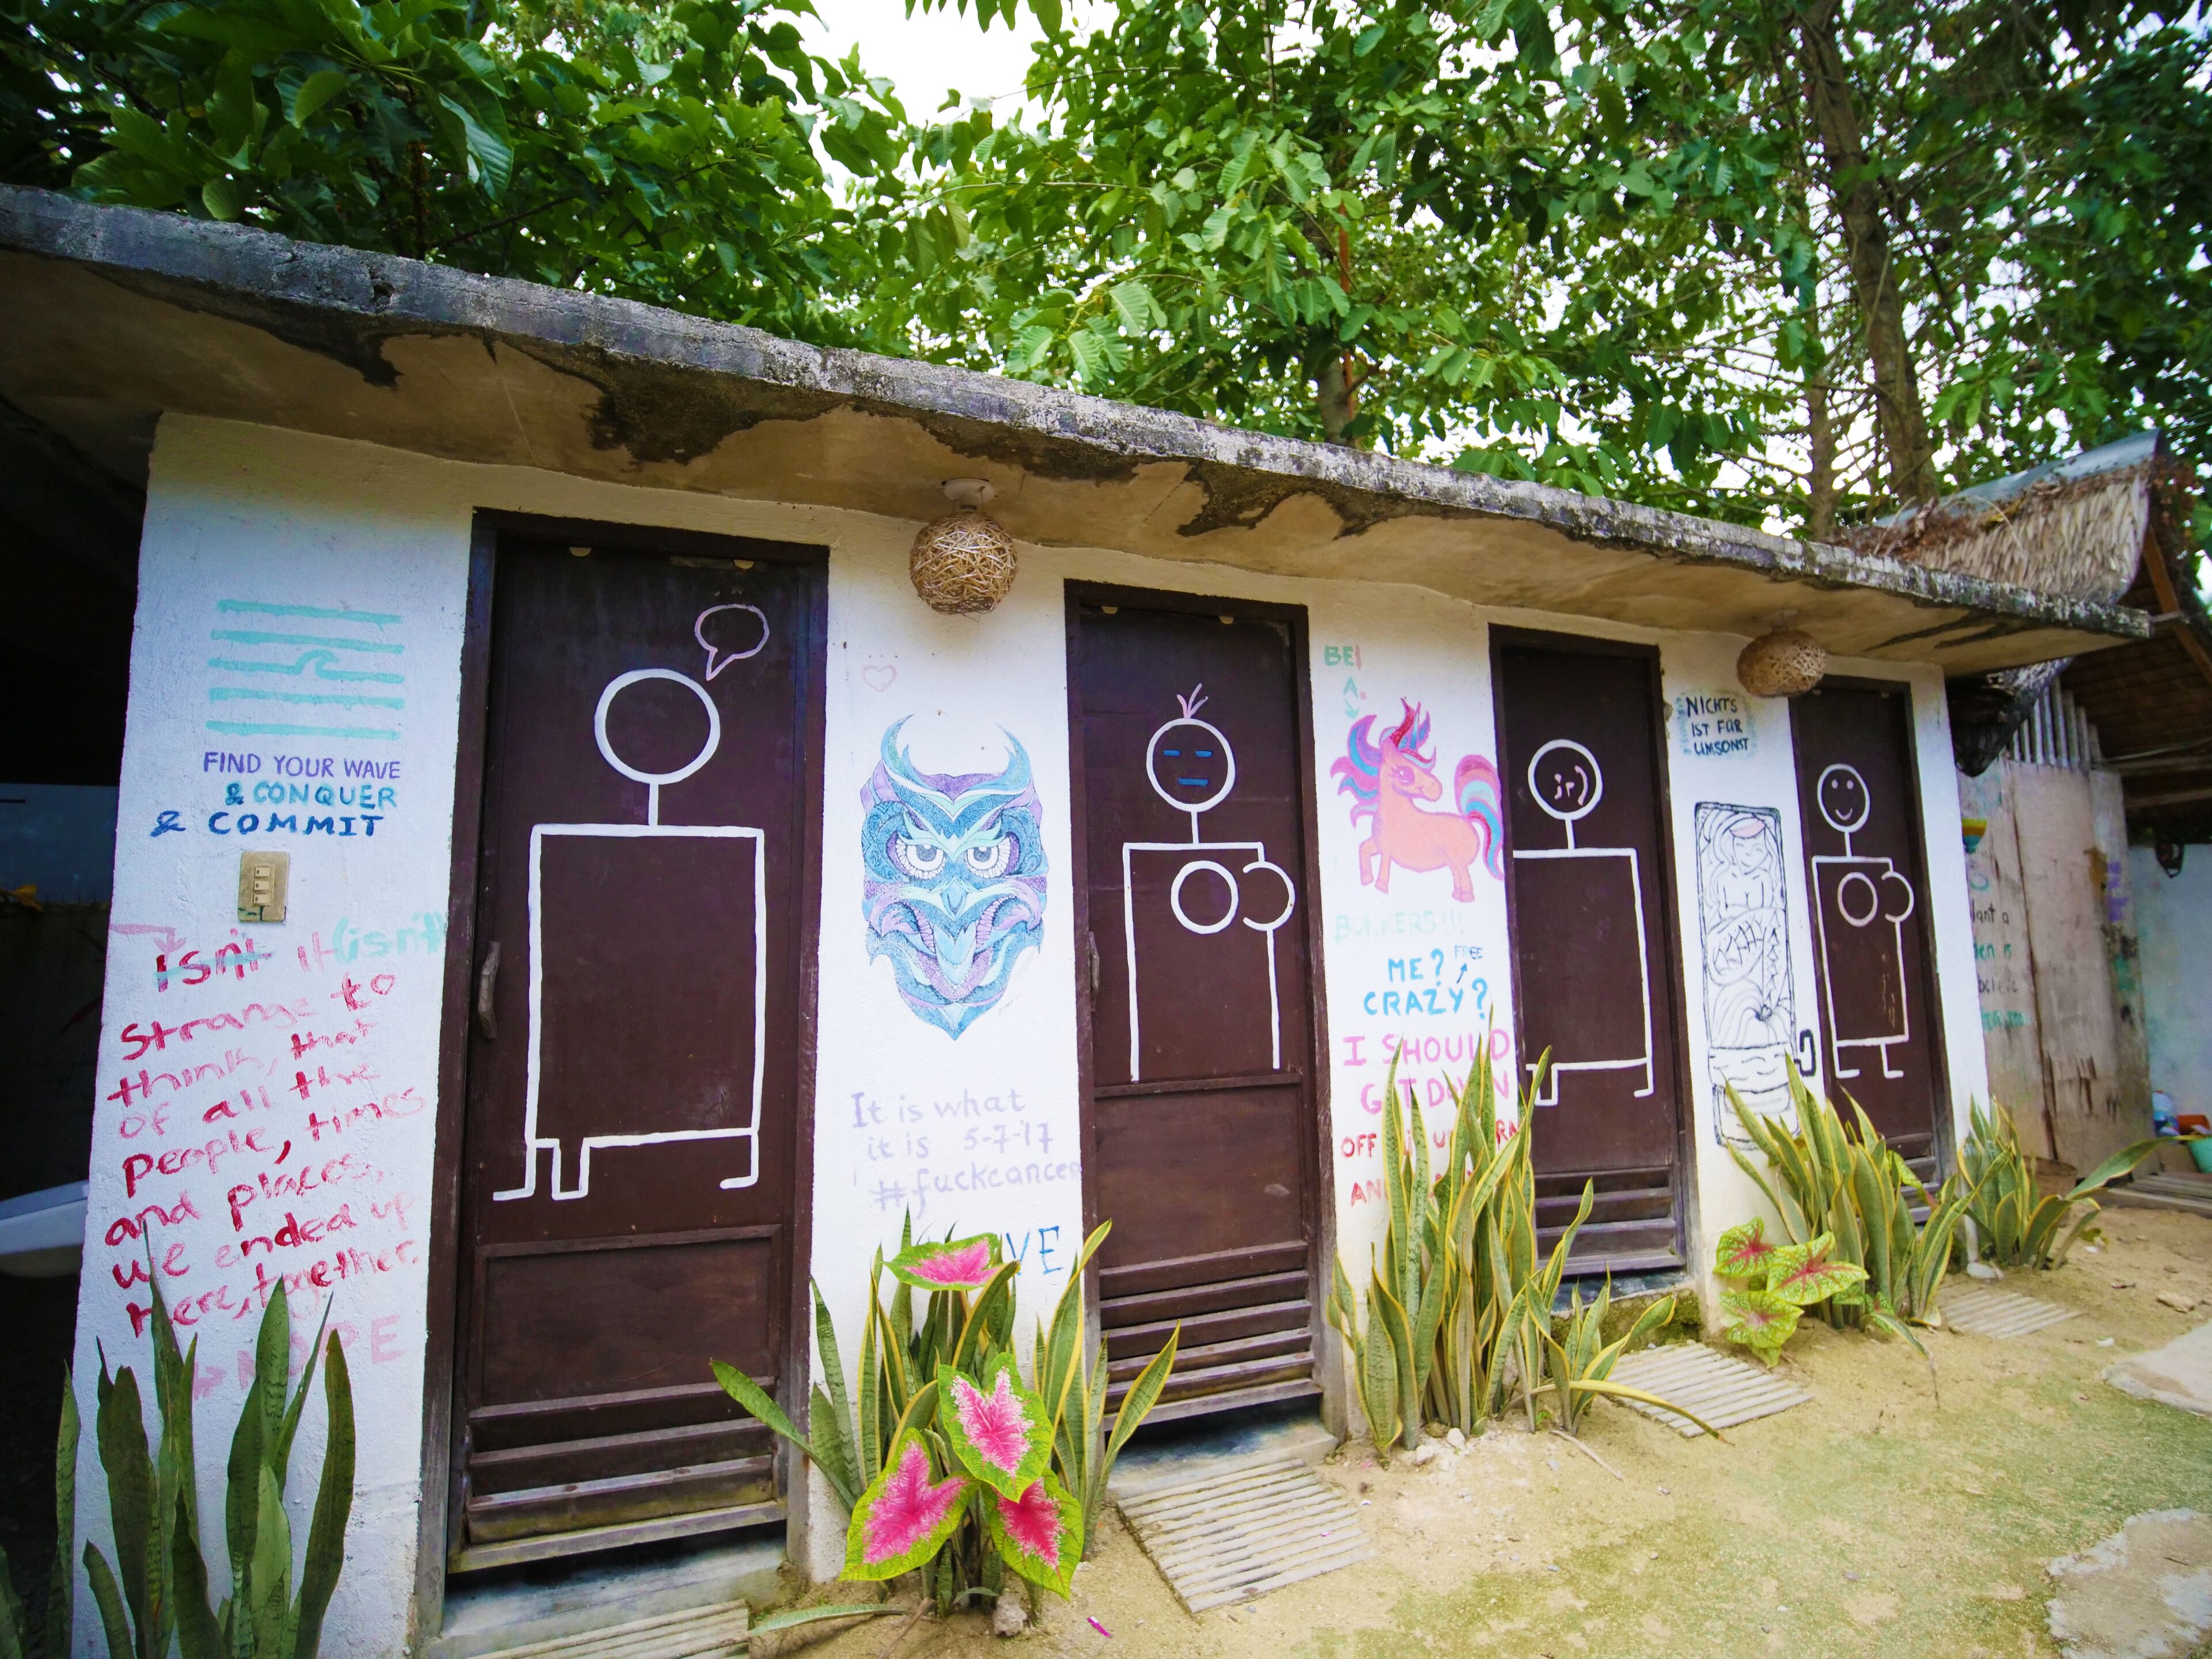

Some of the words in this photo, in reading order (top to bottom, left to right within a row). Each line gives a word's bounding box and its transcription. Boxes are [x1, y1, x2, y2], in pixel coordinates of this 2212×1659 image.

[1686, 696, 1738, 717] NICHTS
[1692, 722, 1710, 737] IST
[1694, 737, 1749, 756] UMSONST
[204, 752, 260, 774] FIND
[274, 756, 335, 778] YOUR
[344, 758, 401, 779] WAVE
[225, 783, 244, 806] &
[252, 782, 396, 809] CONQUER
[208, 811, 384, 836] COMMIT
[1388, 948, 1444, 987] ME?
[1455, 945, 1483, 960] FREE
[330, 972, 396, 1012] to
[1363, 978, 1488, 1019] CRAZY?
[290, 1018, 378, 1060] that
[1343, 1036, 1367, 1066] I
[202, 1085, 272, 1124] all
[288, 1062, 381, 1100] the
[851, 1092, 887, 1127] It
[899, 1095, 924, 1123] is
[933, 1088, 1025, 1118] what
[1360, 1078, 1417, 1115] GT
[868, 1136, 894, 1161] it
[906, 1131, 930, 1159] is
[1340, 1133, 1377, 1158] OFF
[122, 1127, 291, 1199] people,
[1350, 1178, 1389, 1207] AN
[105, 1189, 203, 1246] and
[112, 1242, 190, 1289] we
[214, 1203, 358, 1269] ended
[371, 1191, 415, 1230] up
